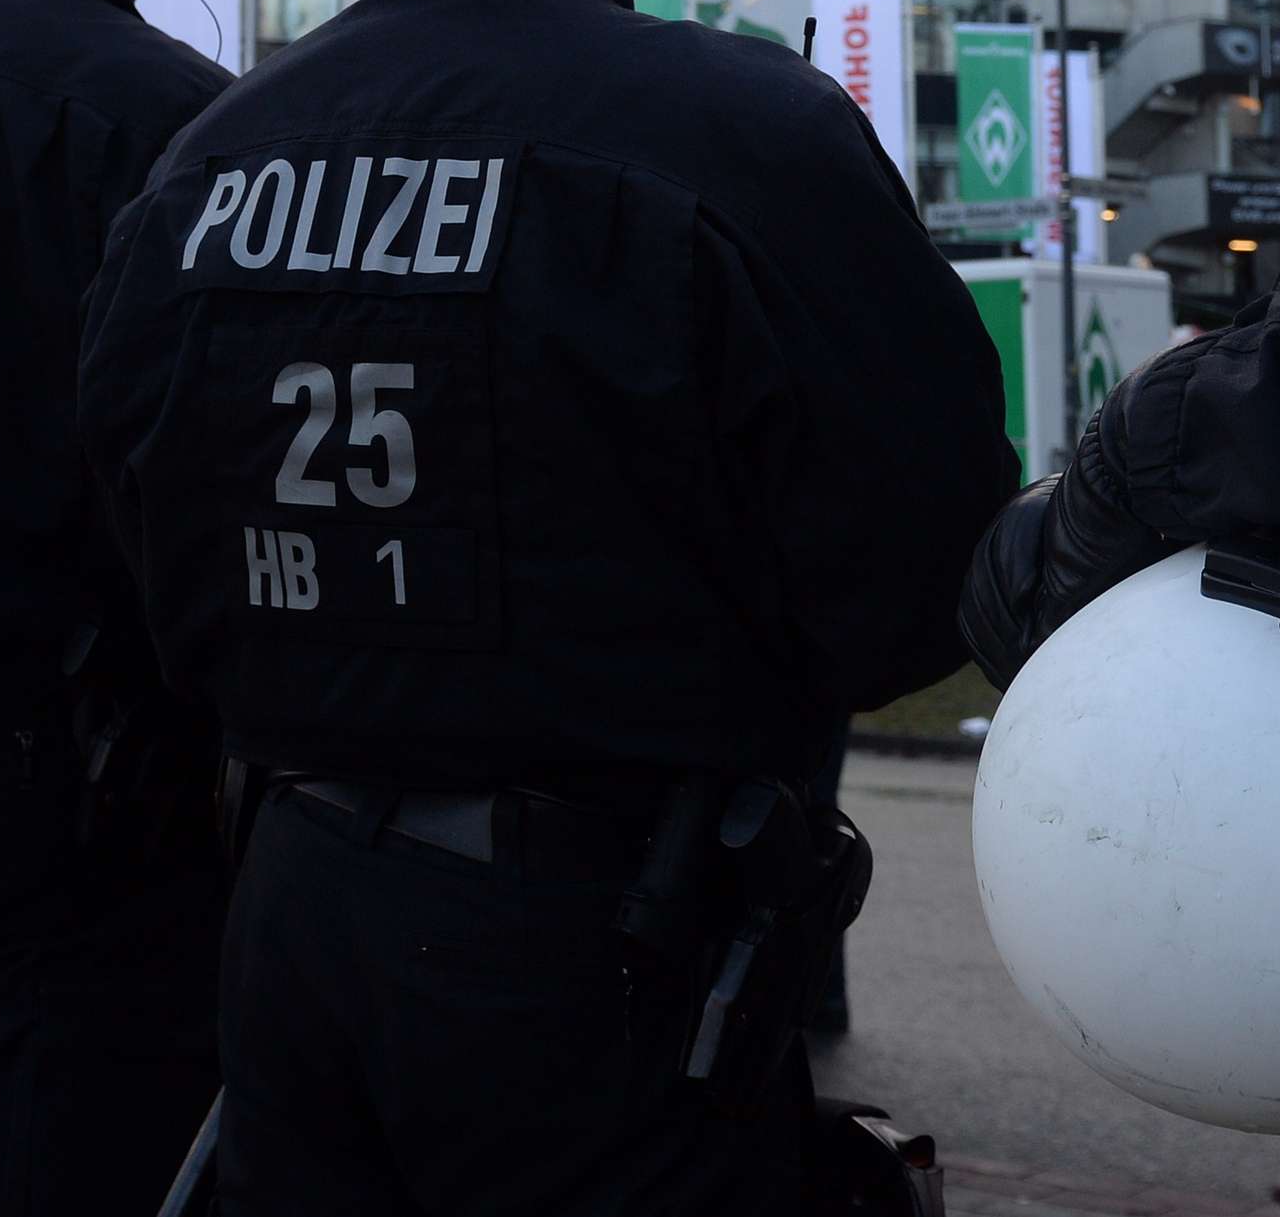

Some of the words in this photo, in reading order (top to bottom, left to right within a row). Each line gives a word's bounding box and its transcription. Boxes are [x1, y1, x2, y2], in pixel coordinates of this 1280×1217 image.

[181, 156, 505, 275] POLIZEI
[271, 361, 417, 508] 25
[244, 526, 320, 611] HB
[376, 539, 407, 606] 1
